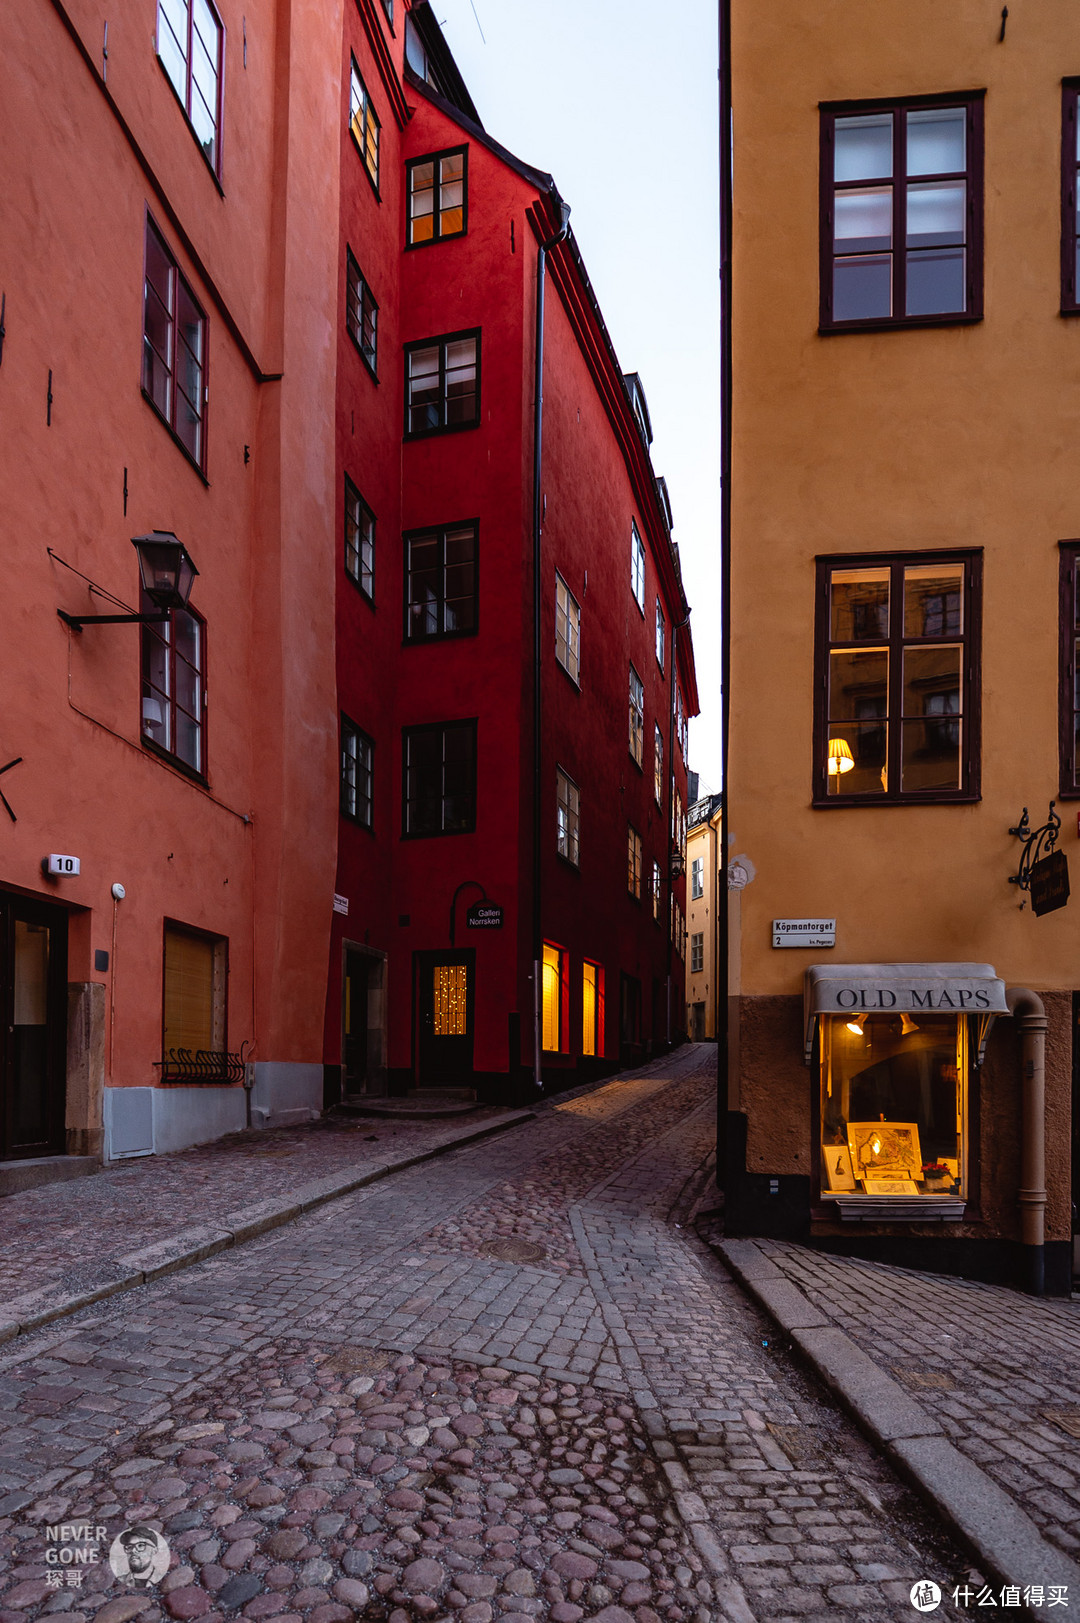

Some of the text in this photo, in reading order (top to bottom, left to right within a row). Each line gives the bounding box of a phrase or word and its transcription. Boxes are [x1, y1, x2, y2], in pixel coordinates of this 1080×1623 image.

[57, 858, 73, 871] 10
[478, 909, 500, 917] Galleri
[776, 922, 833, 932] Köpmantorget
[776, 937, 781, 945] 2
[836, 989, 990, 1008] OLD MAPS
